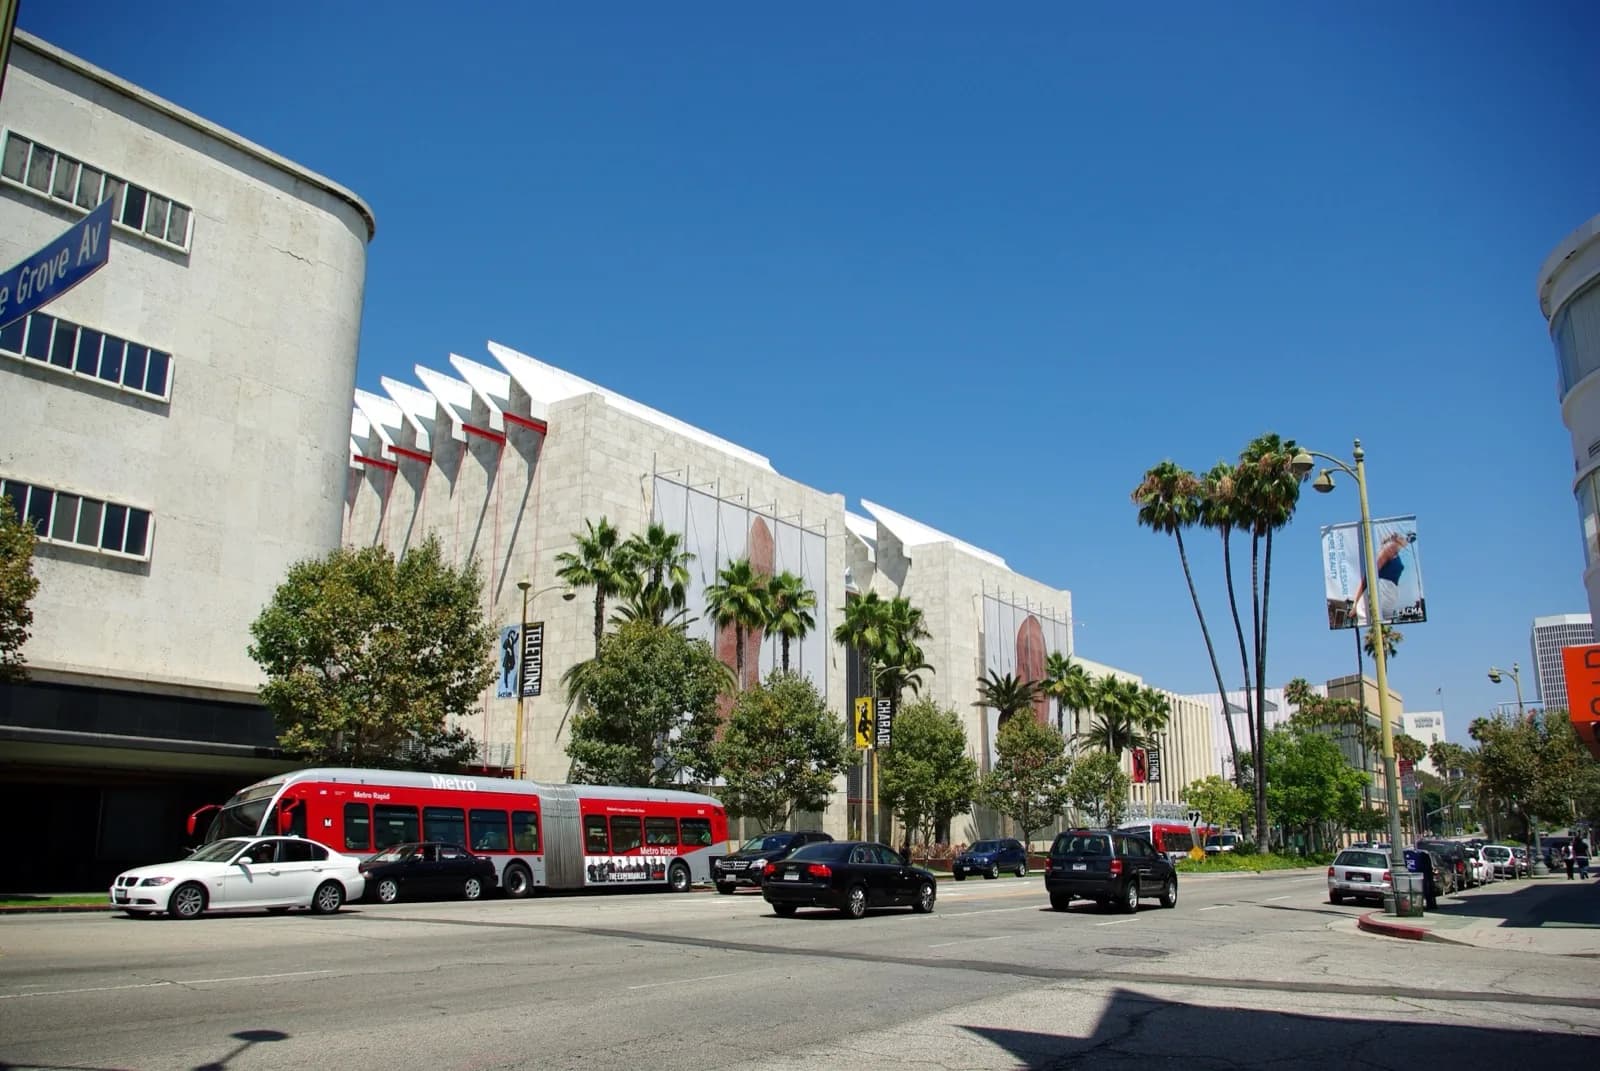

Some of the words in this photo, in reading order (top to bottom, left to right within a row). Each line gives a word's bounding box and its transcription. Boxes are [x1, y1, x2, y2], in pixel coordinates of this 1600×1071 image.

[17, 247, 70, 304] Grove
[77, 223, 103, 267] Av
[1398, 607, 1423, 616] LACMA
[524, 627, 542, 687] TELETHON
[877, 700, 890, 745] CHARADE
[430, 775, 477, 791] Metro
[353, 791, 372, 799] Metro
[373, 792, 391, 800] Rapid
[640, 847, 659, 855] Metro
[660, 847, 677, 856] Rapid
